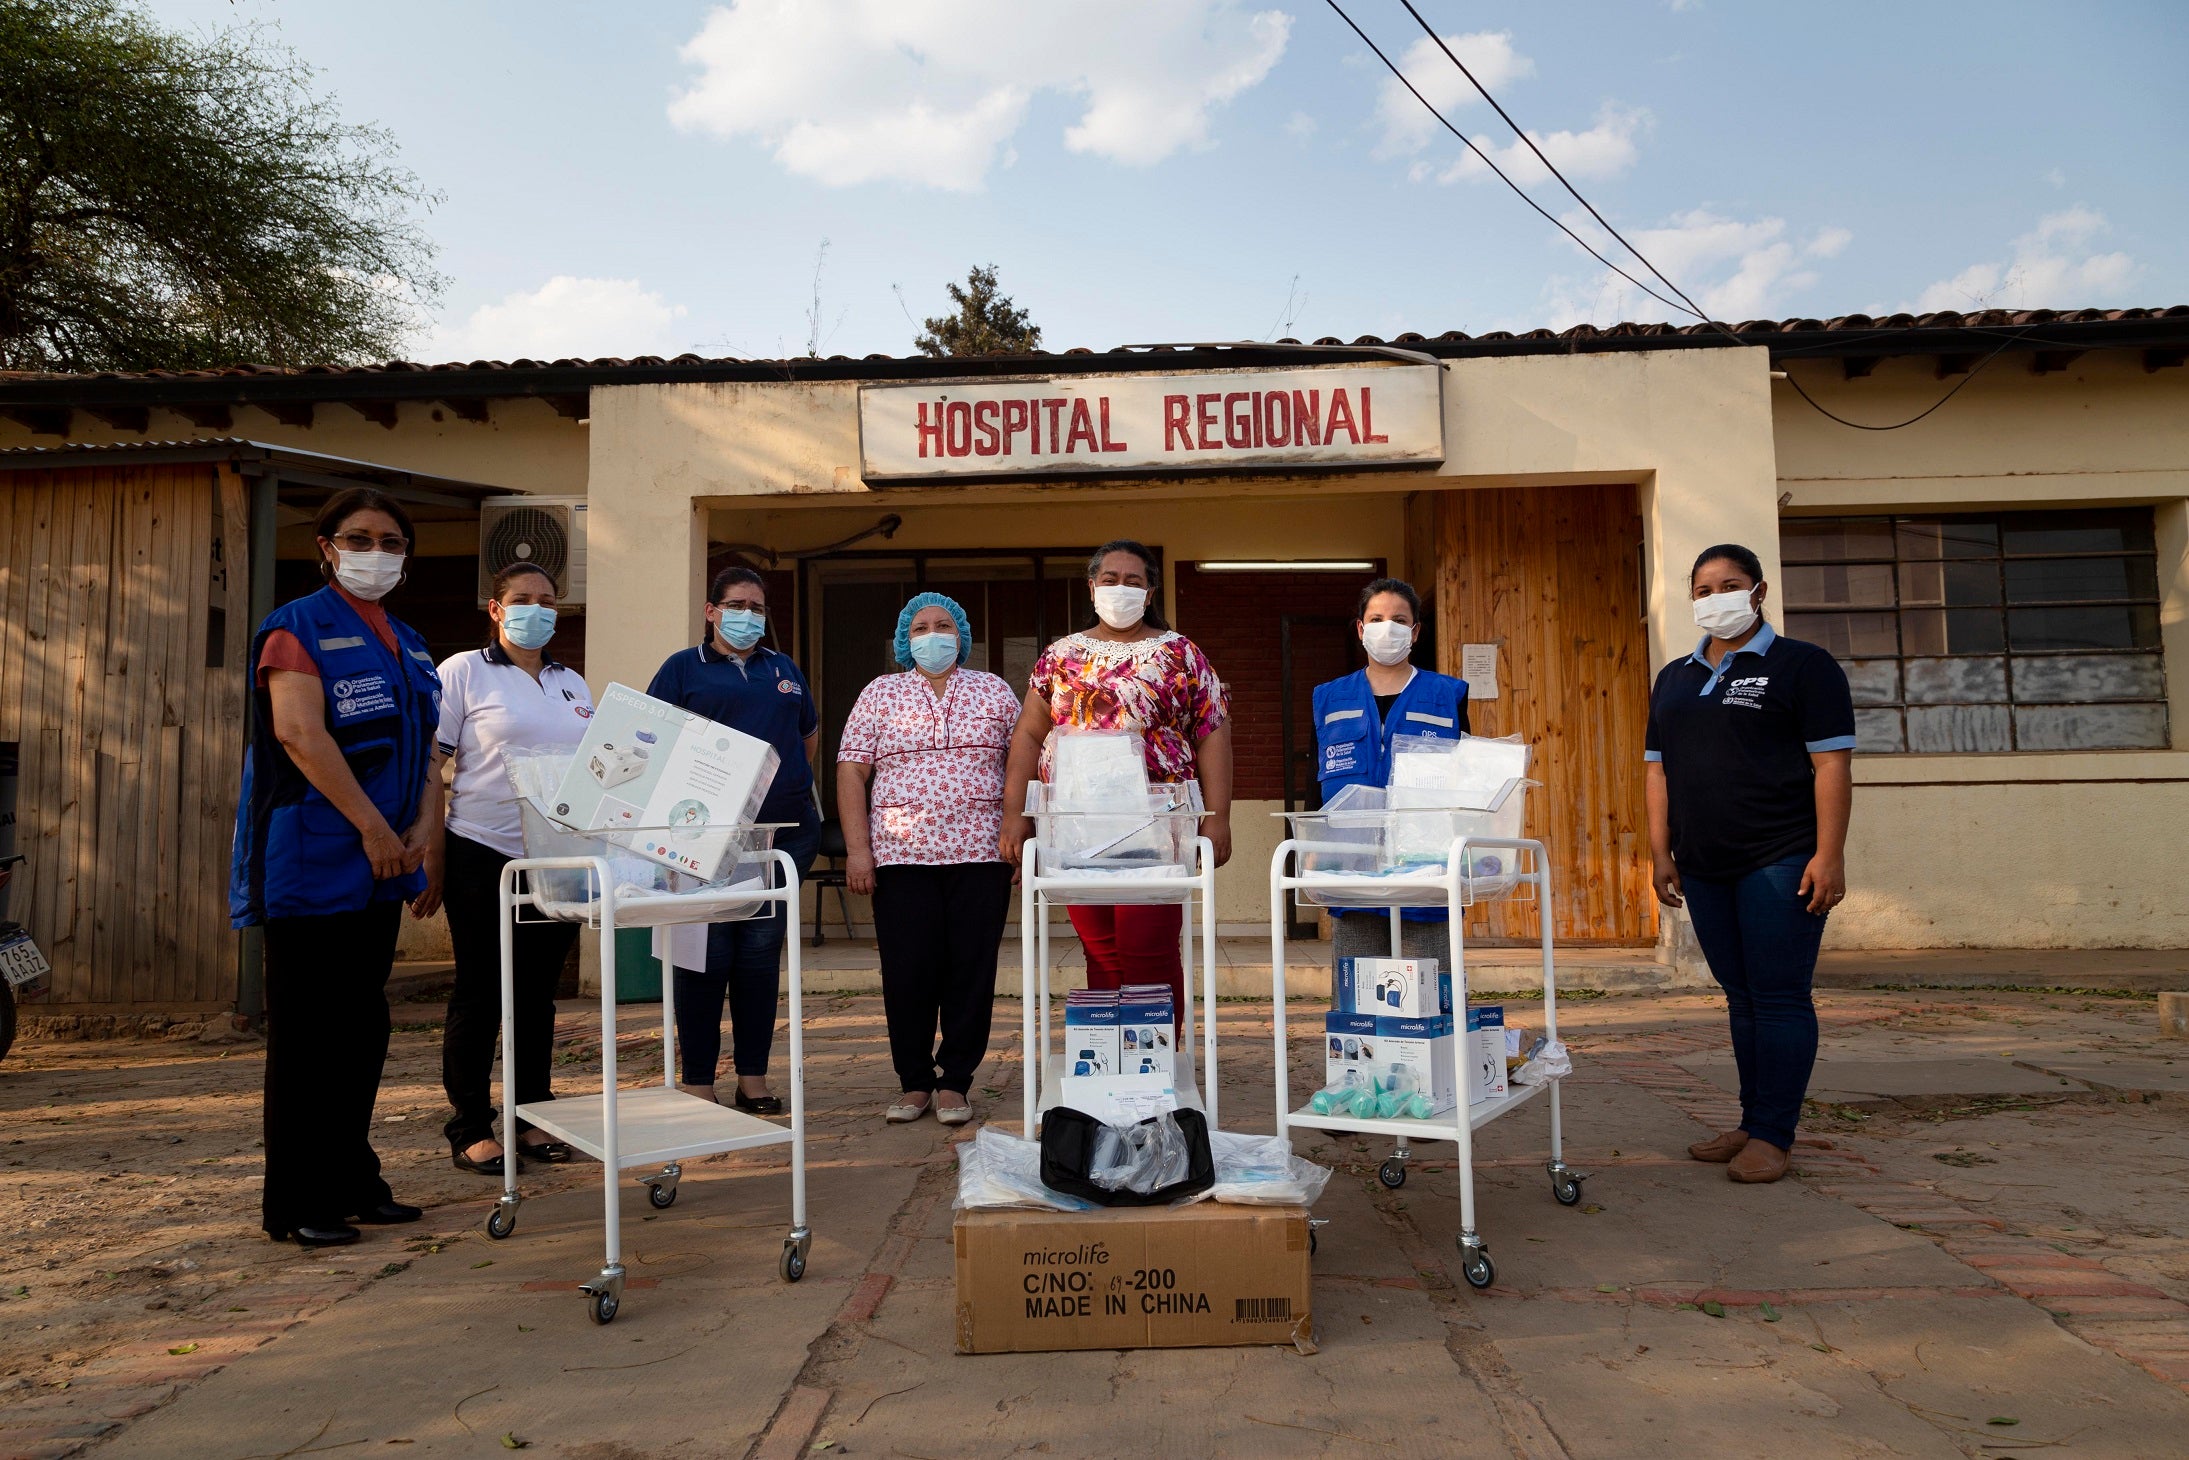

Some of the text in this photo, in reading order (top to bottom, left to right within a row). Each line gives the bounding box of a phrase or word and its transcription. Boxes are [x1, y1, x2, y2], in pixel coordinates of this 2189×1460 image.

[917, 386, 1389, 458] HOSPITAL REGIONAL
[1730, 676, 1769, 687] OPS
[609, 690, 665, 718] ASPEED 3.0
[1, 945, 30, 966] 765
[10, 957, 45, 981] AAJZ
[1349, 1020, 1374, 1028] microlife
[1480, 1011, 1499, 1019] icrolife
[1400, 1023, 1425, 1031] microlife
[1023, 1243, 1110, 1266] microlife
[1023, 1270, 1093, 1294] C/NO:
[1025, 1293, 1211, 1318] MADE IN CHINA
